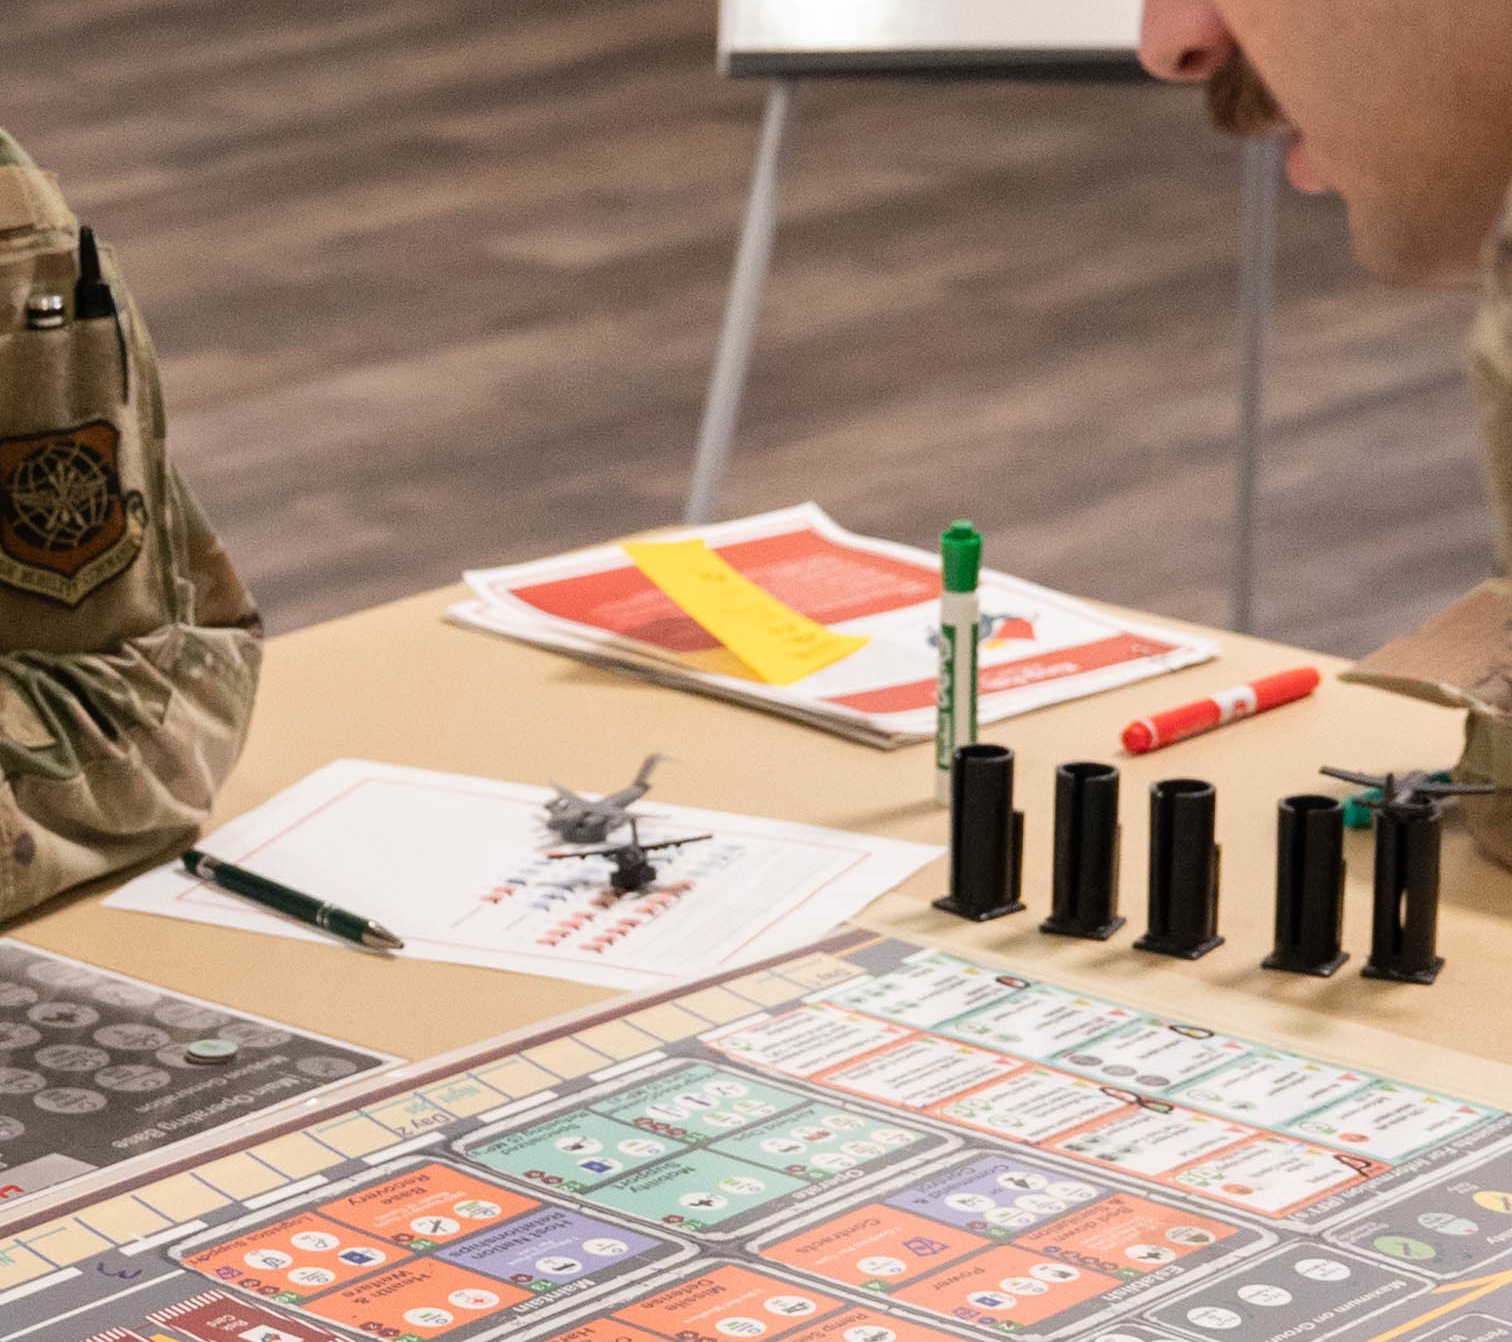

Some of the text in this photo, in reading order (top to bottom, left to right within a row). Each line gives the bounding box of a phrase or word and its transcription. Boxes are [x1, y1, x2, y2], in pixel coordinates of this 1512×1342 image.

[413, 1109, 451, 1132] Day
[346, 1170, 431, 1207] Recovery
[384, 1179, 428, 1202] Base
[447, 1207, 569, 1260] Relationships
[470, 1231, 534, 1263] Nation
[794, 1216, 882, 1256] Contracts
[512, 1275, 595, 1316] Maintain
[930, 1265, 985, 1292] Power
[1101, 1262, 1185, 1302] Establish
[1335, 1277, 1408, 1318] Maximum
